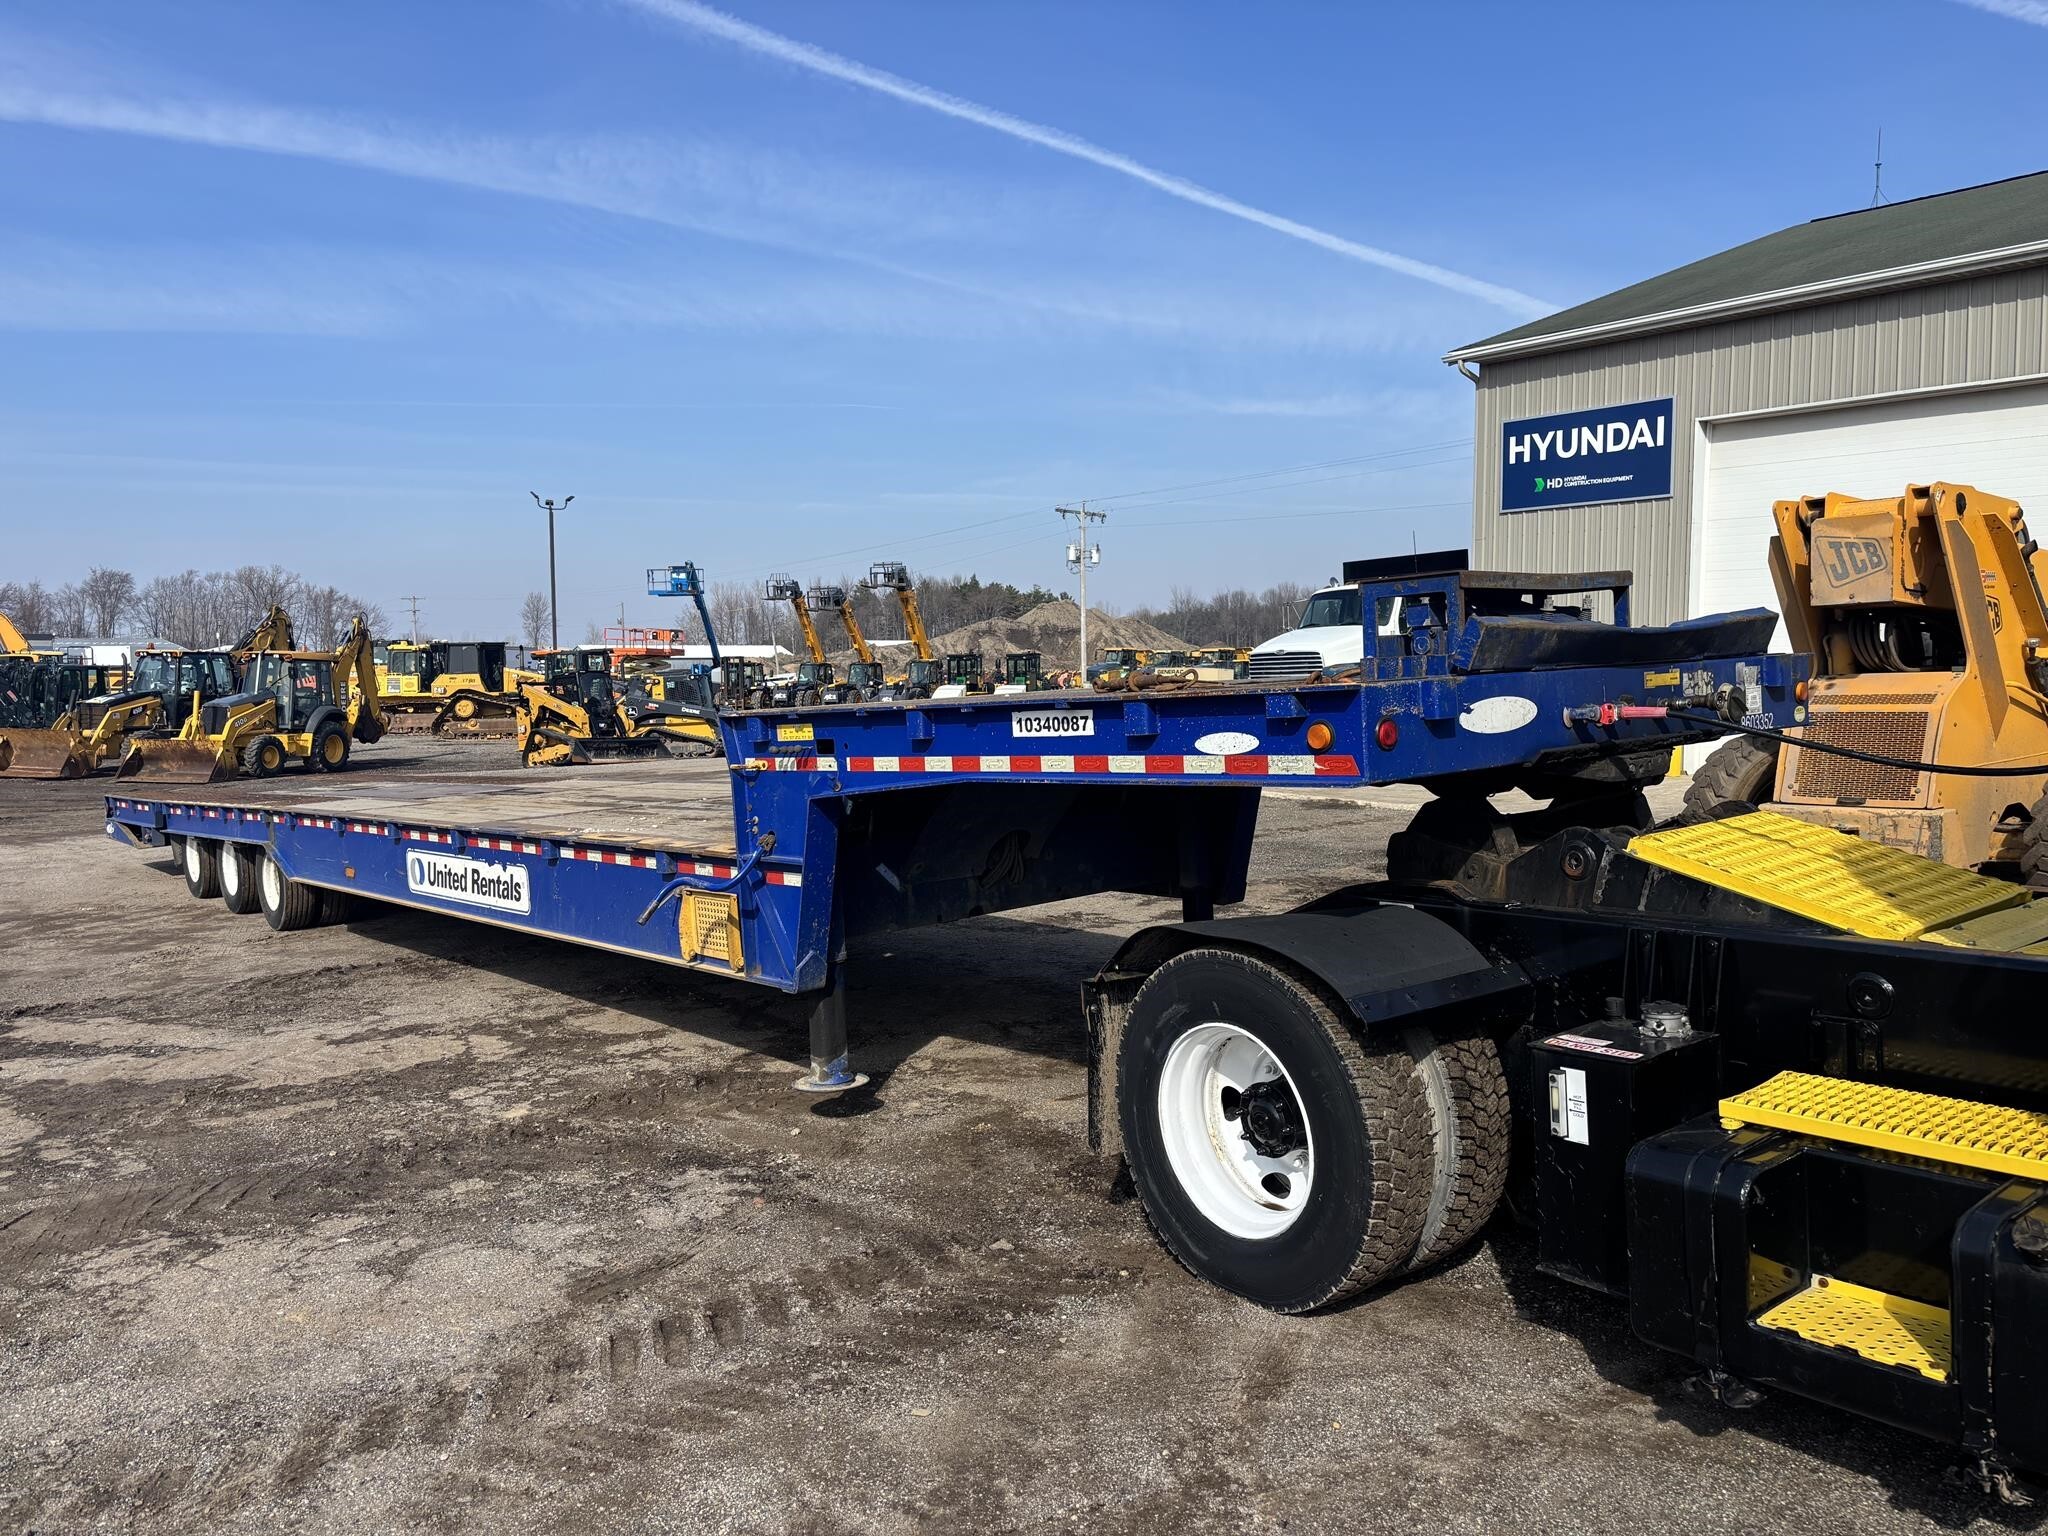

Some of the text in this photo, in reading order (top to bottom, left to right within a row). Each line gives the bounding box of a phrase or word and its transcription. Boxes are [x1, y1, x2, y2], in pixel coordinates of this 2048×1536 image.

[1508, 415, 1665, 465] HYUNDAI
[1546, 477, 1563, 489] HD
[1563, 475, 1634, 488] CONSTRUCTION EQUIPMENT
[1827, 541, 1883, 582] JCB
[1986, 599, 2001, 631] CB
[340, 681, 348, 713] DEERE
[1016, 715, 1089, 733] 10340087
[1741, 713, 1773, 729] 8603352
[427, 861, 522, 902] United Rentals
[1600, 1048, 1639, 1058] STEP
